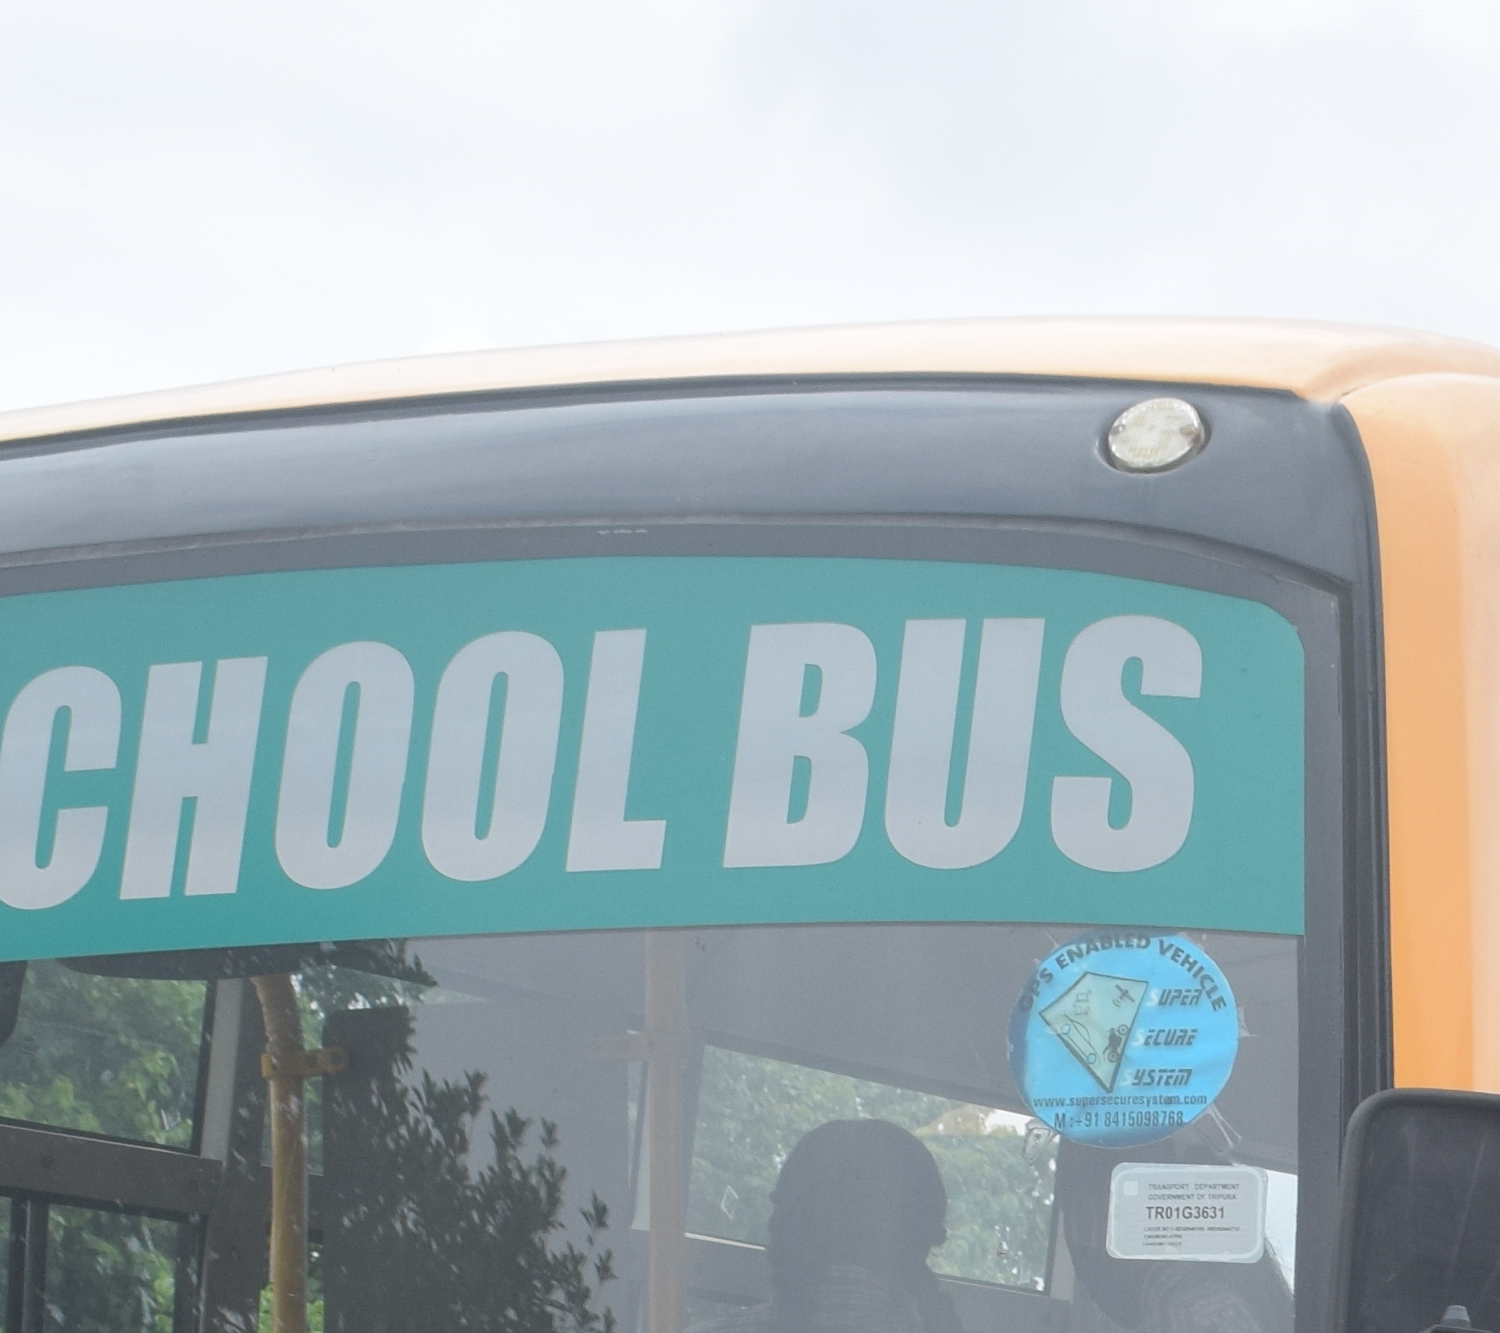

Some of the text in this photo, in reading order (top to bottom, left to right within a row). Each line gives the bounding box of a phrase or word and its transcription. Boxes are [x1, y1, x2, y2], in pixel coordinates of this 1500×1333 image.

[722, 613, 1203, 873] BUS
[1018, 933, 1228, 1013] GPS ENABLED VEHICLE
[1146, 988, 1204, 1007] SUPER
[1132, 1028, 1198, 1047] SECURE
[1119, 1068, 1193, 1087] SYSTEM
[1104, 1110, 1184, 1128] 8415098768
[1146, 1206, 1225, 1220] TR01G3631
